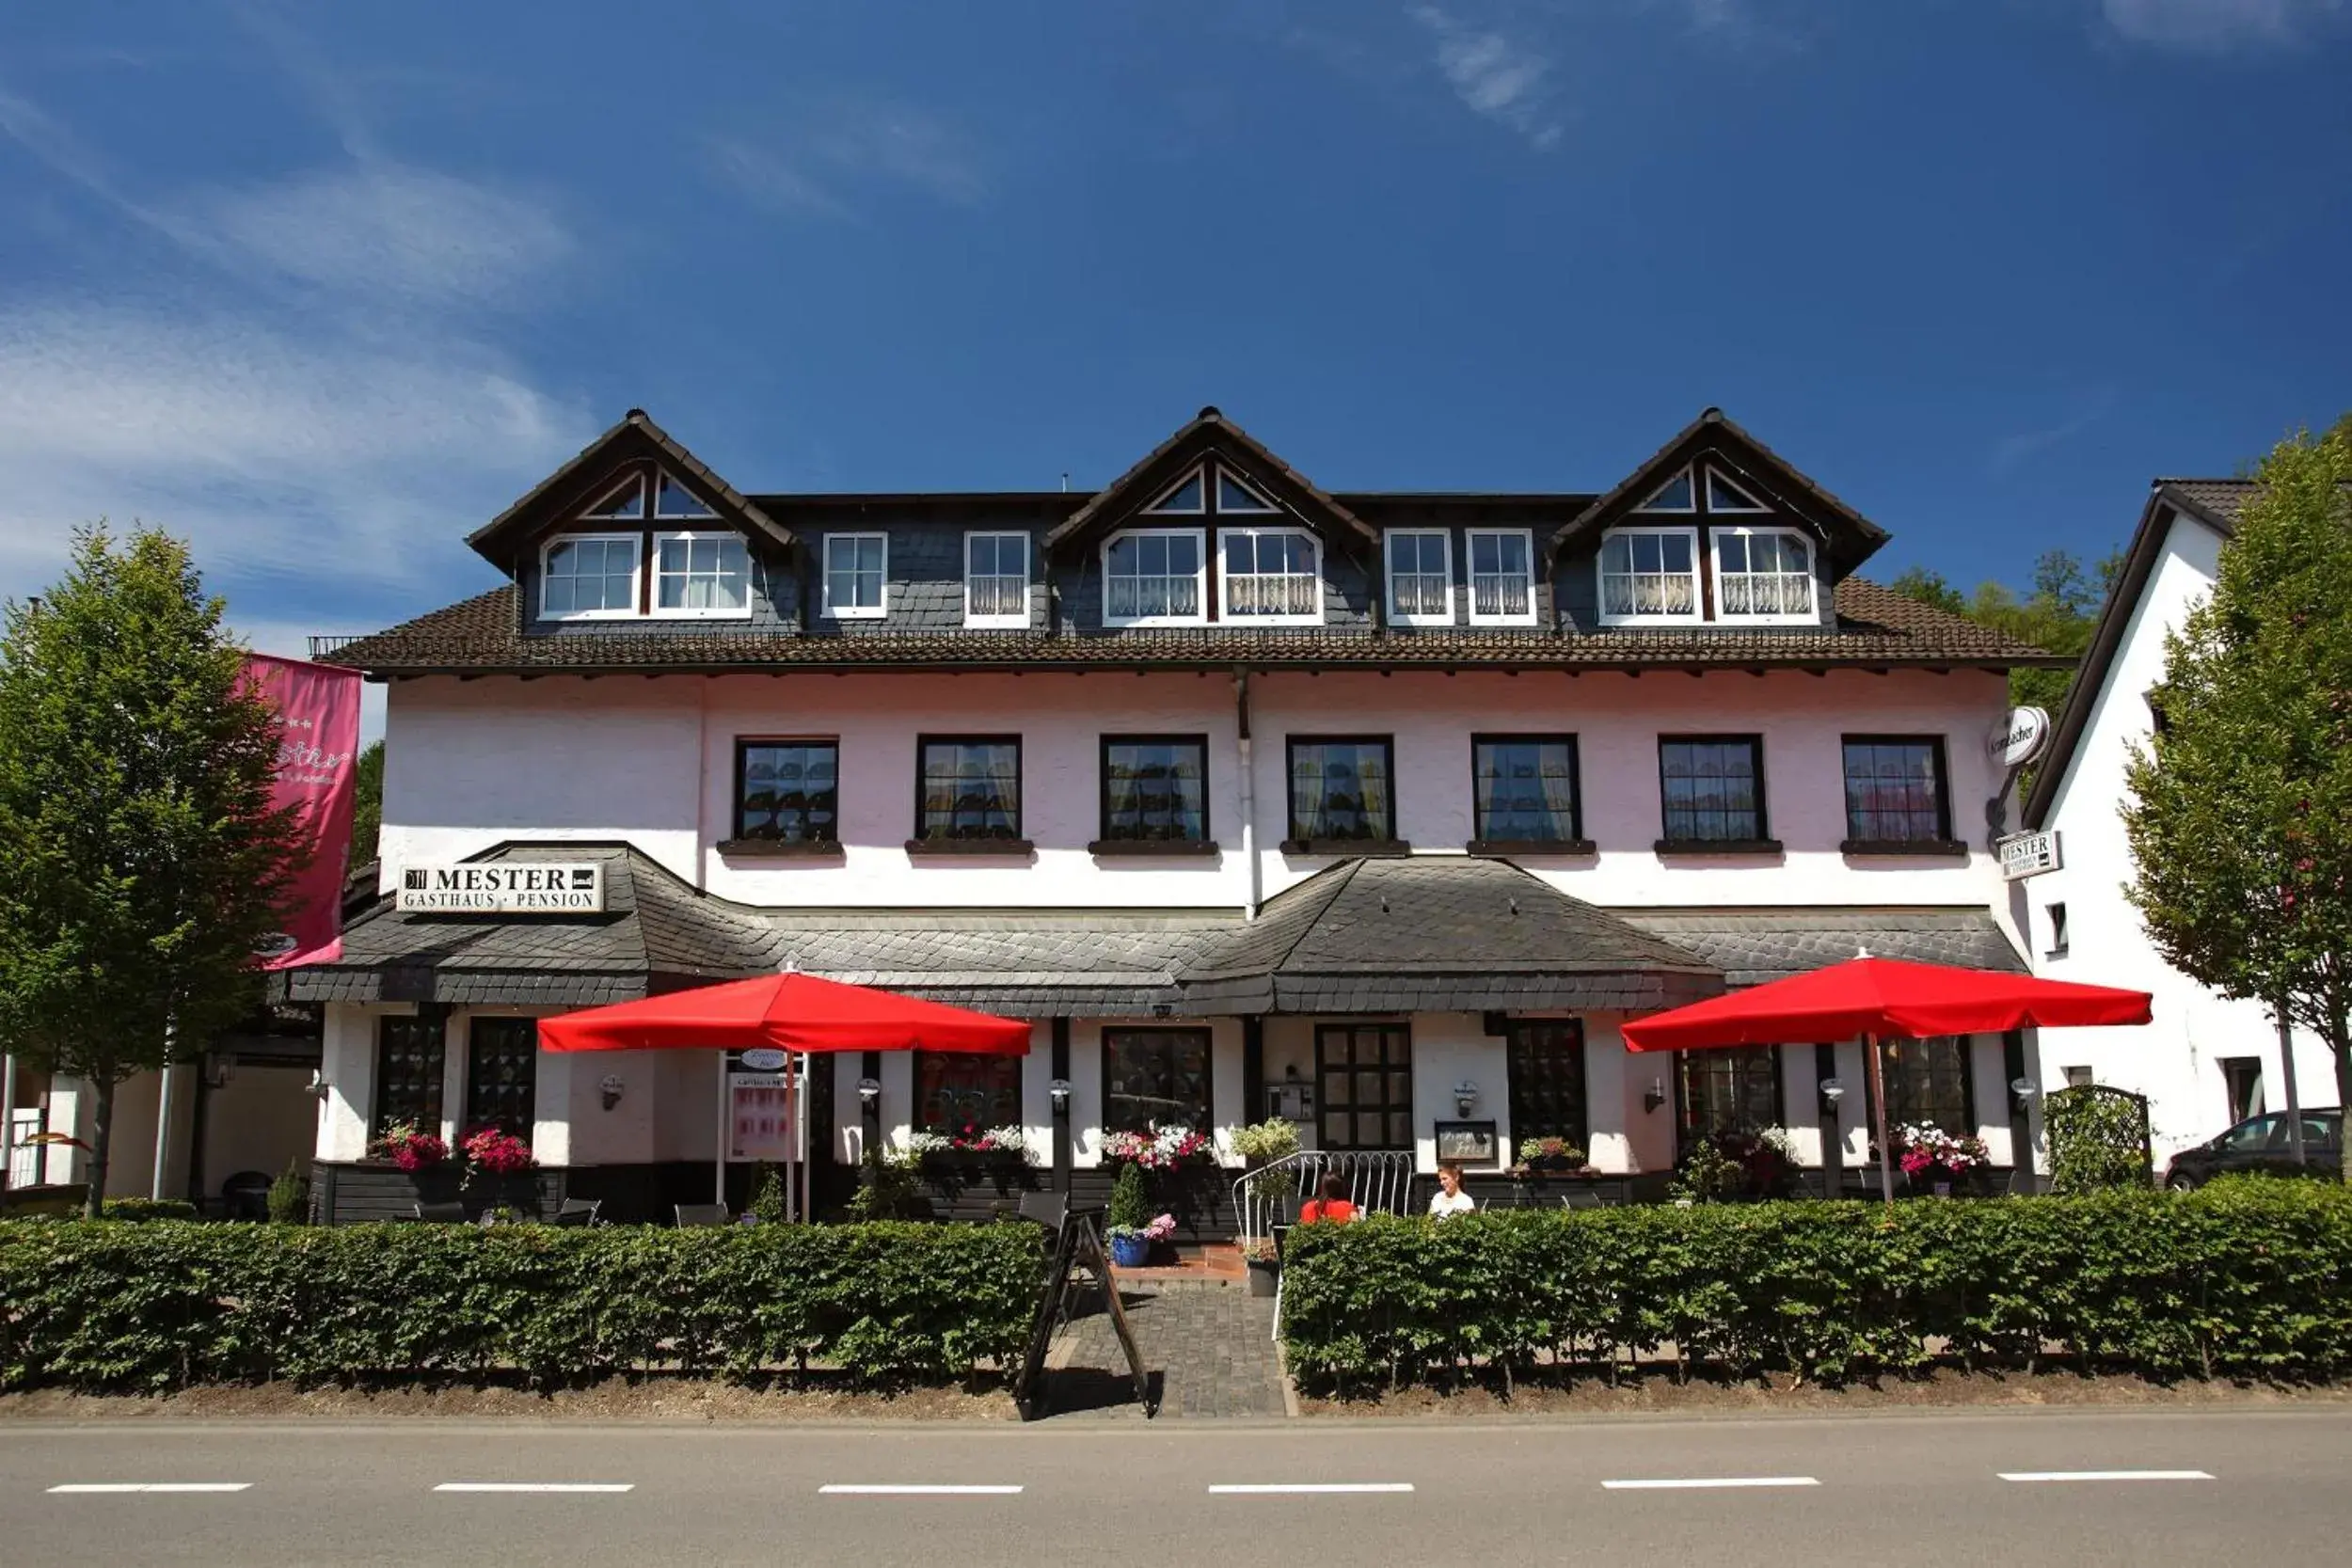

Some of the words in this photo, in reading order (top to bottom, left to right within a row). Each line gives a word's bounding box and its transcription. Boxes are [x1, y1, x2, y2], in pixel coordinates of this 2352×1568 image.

[437, 868, 565, 891] MESTER
[405, 895, 495, 908] GASTHAUS
[516, 895, 594, 908] PENSION
